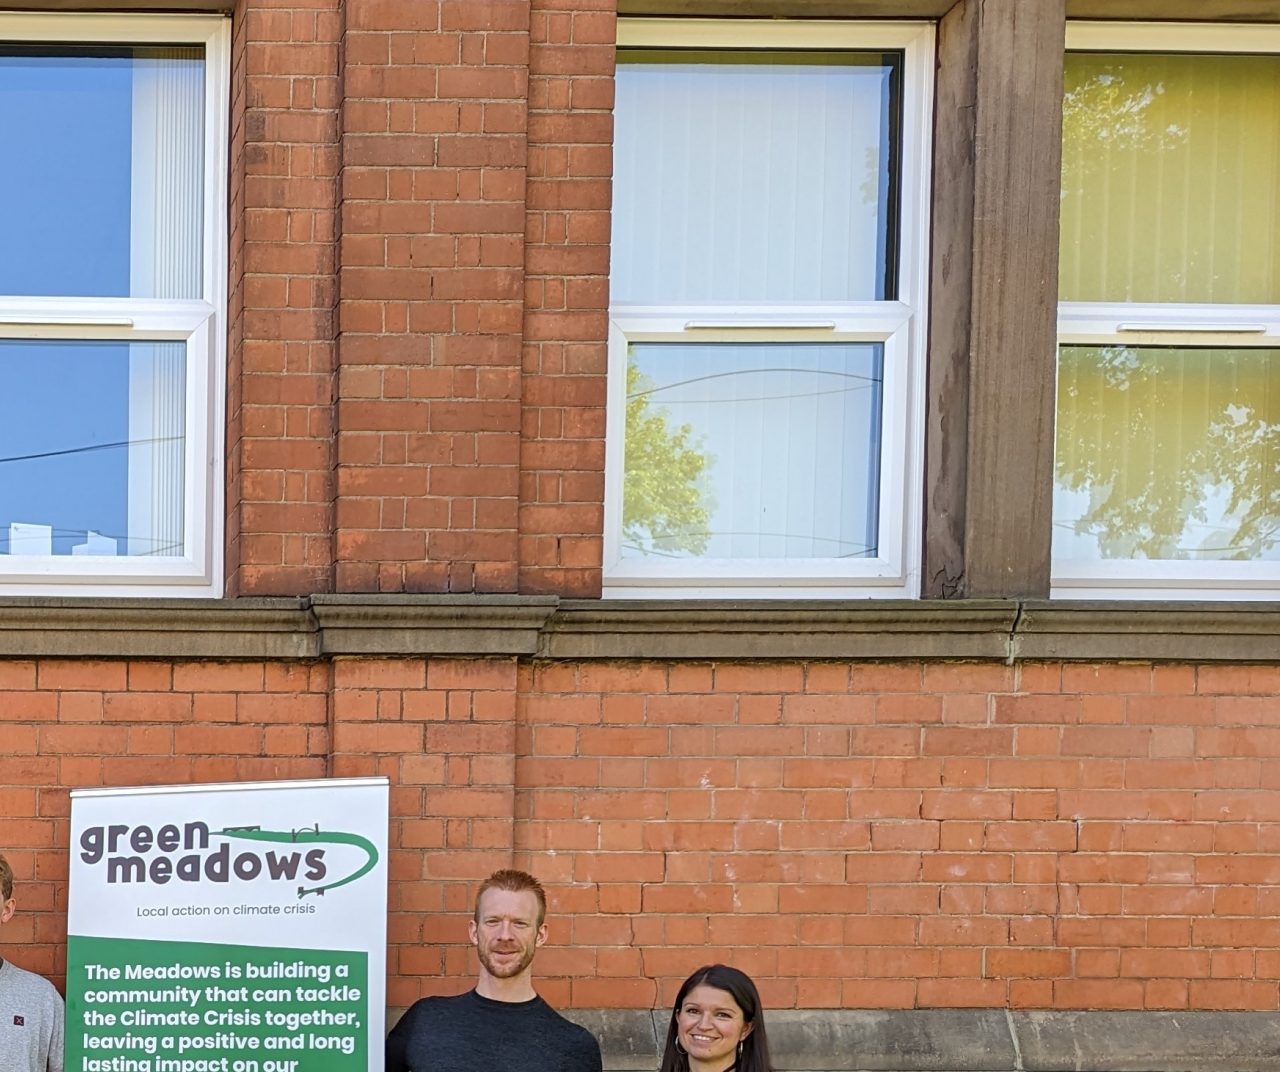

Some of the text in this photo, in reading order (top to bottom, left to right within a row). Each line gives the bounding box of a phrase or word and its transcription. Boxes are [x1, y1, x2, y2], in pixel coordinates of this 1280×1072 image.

[80, 821, 209, 864] green
[107, 843, 327, 884] meadows
[137, 903, 315, 917] Local action on climate crisis
[85, 962, 348, 982] The Meadows is building a
[84, 986, 361, 1007] community that can tackle
[84, 1009, 360, 1031] the Climate Crisis together,
[83, 1033, 354, 1054] leaving a positive and long
[232, 1060, 258, 1072] on
[263, 1060, 298, 1072] our
